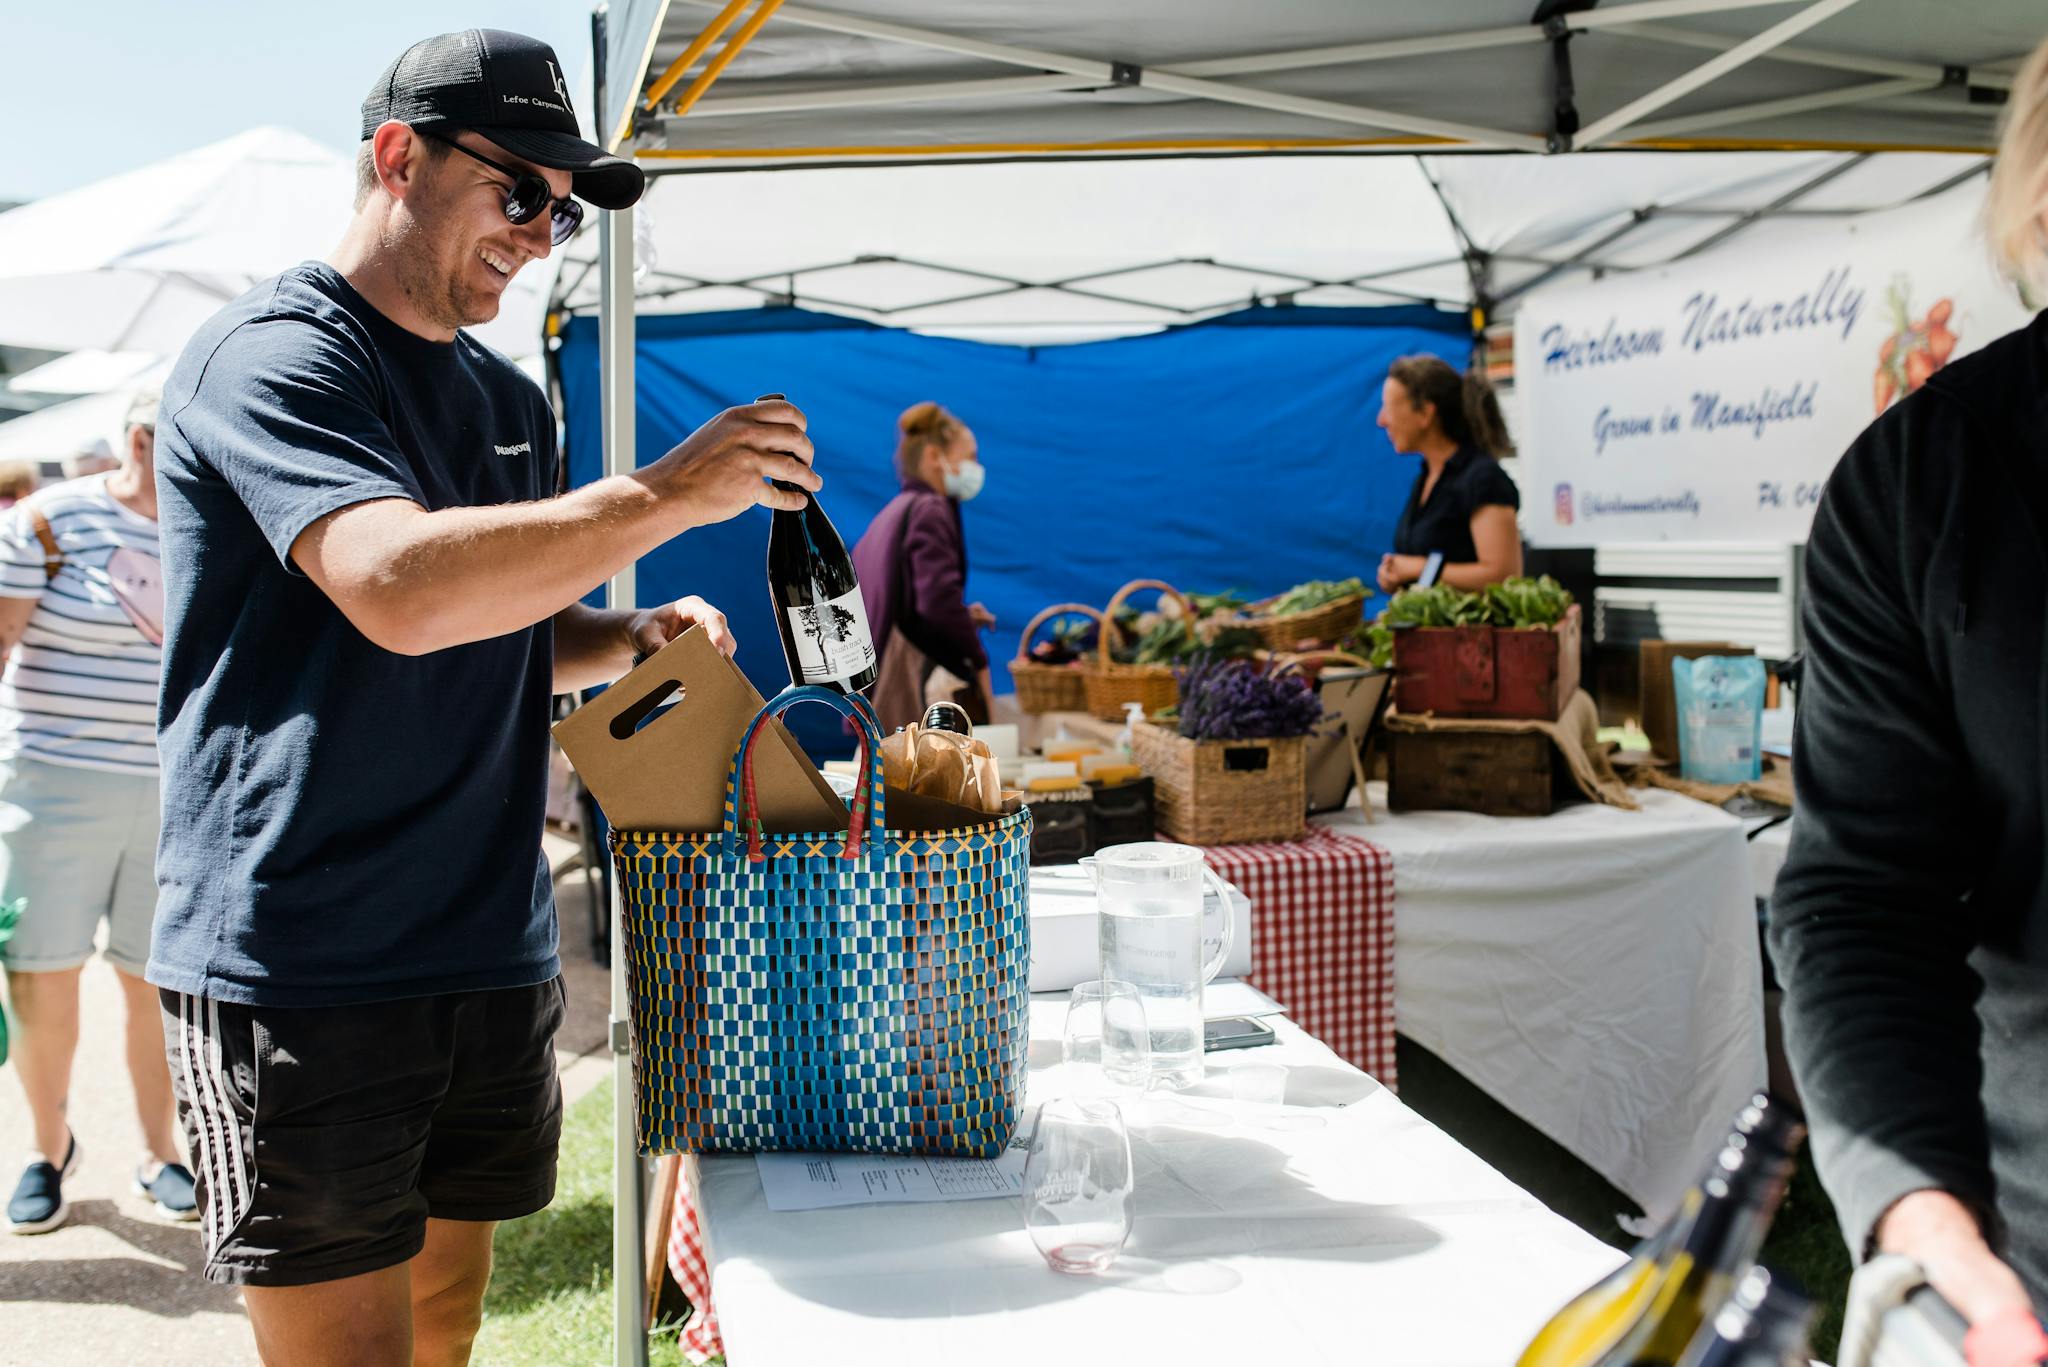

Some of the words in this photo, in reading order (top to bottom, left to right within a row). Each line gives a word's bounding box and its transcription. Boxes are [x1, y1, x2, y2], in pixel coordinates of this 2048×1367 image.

[503, 95, 529, 104] Lefoe
[1541, 317, 1665, 373] Heirloom
[1682, 266, 1865, 352] Naturally
[1594, 404, 1652, 457] Grown
[1661, 406, 1681, 434] in
[1691, 381, 1818, 438] Mansfield
